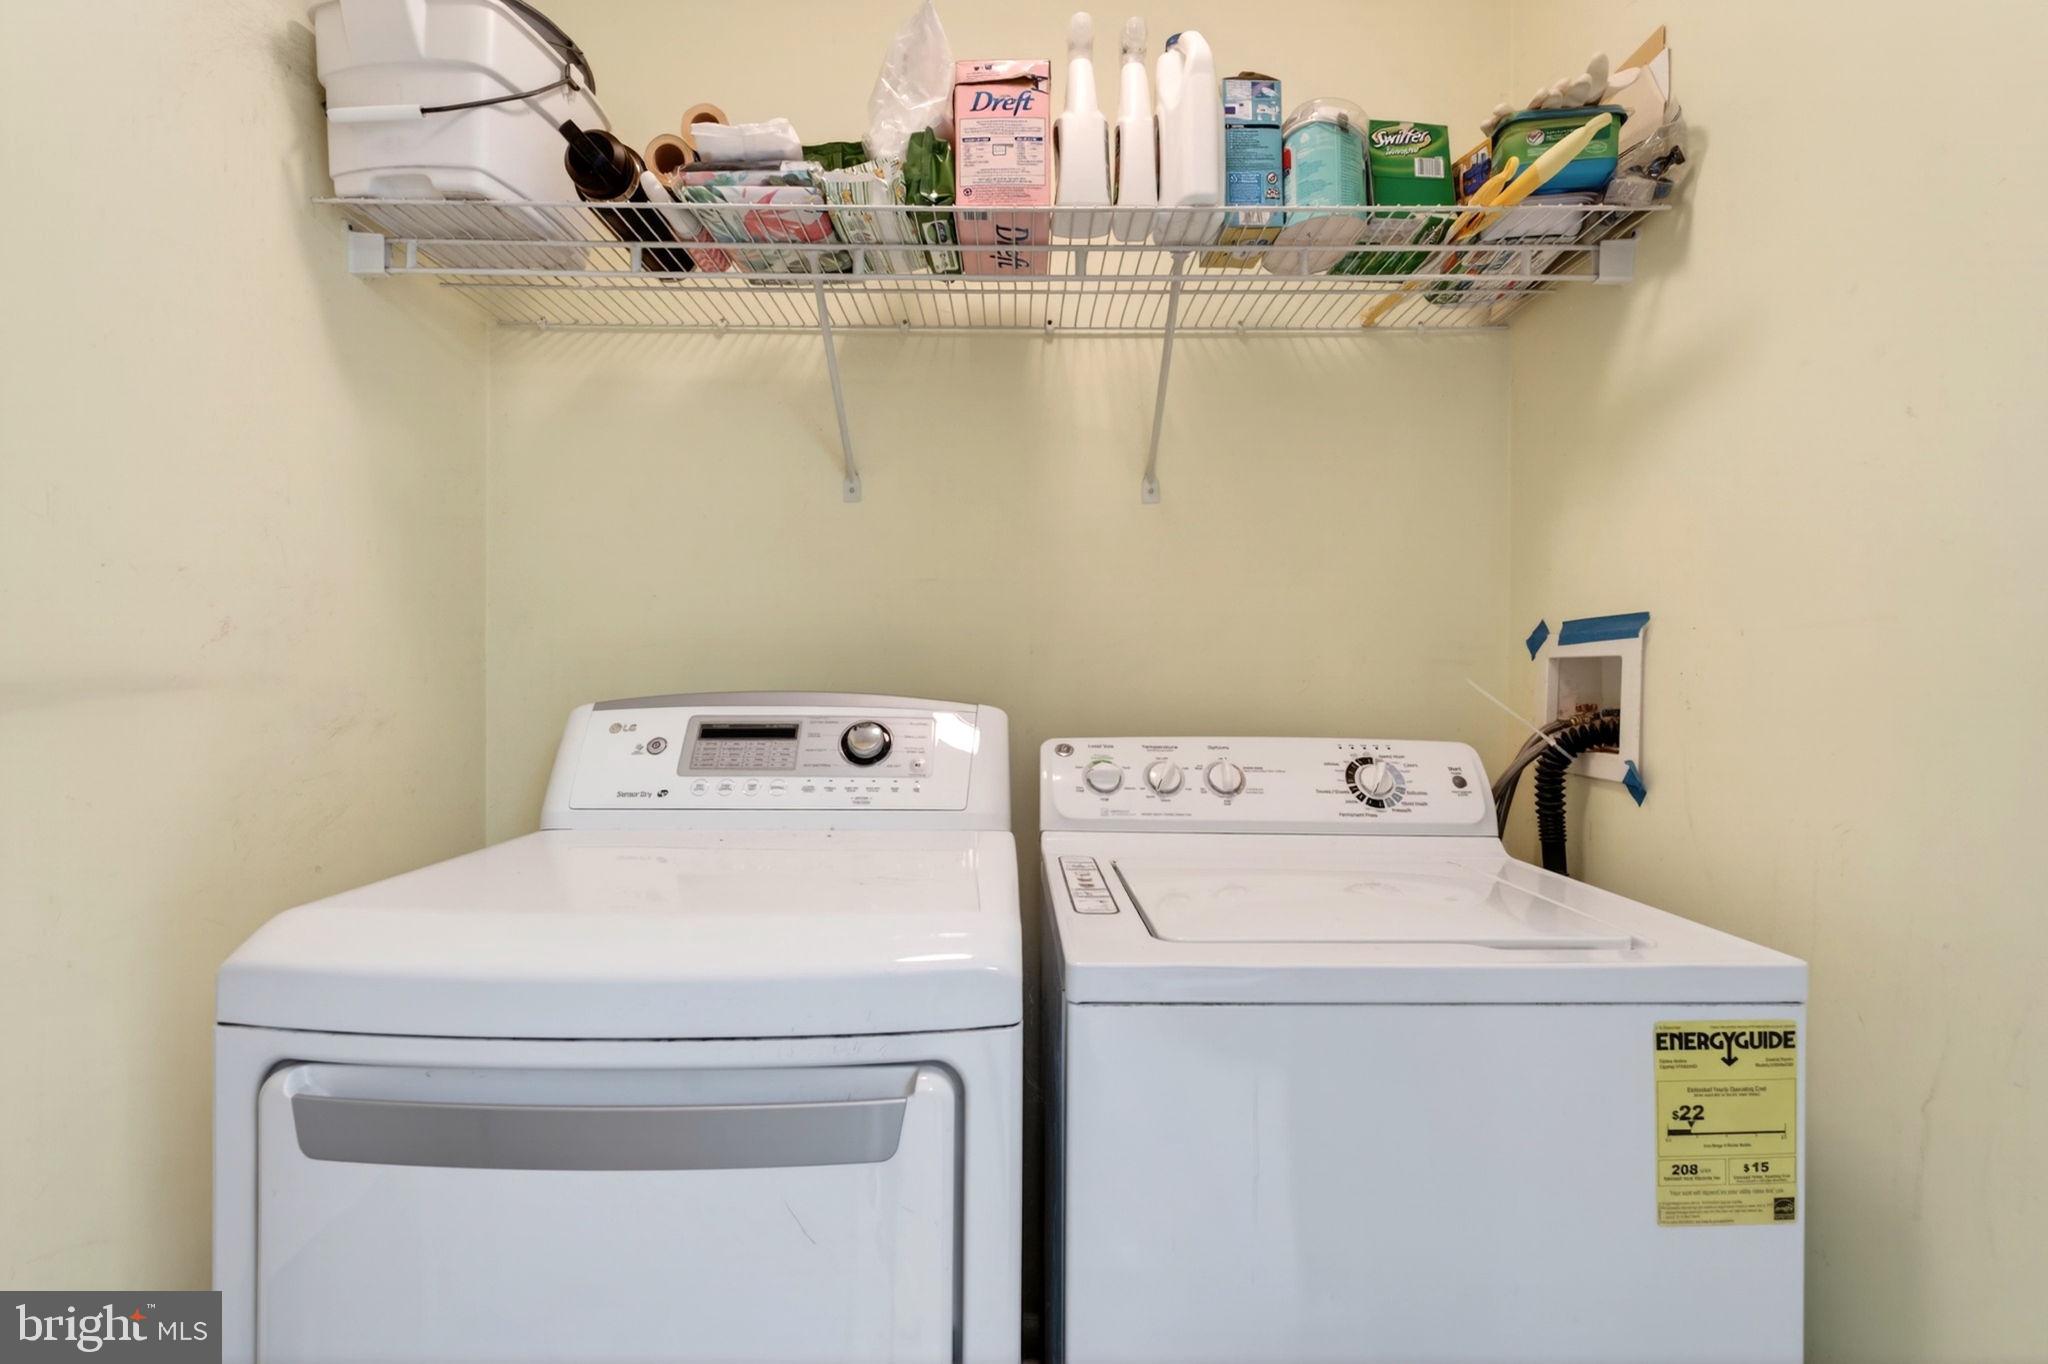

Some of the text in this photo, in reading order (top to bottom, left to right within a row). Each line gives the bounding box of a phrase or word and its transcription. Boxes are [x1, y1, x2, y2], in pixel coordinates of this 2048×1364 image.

[970, 91, 1034, 116] Dreft
[1374, 127, 1429, 148] Swiffer
[1656, 1031, 1796, 1051] ENERGYGUIDE
[1672, 1105, 1705, 1121] $22
[1672, 1164, 1698, 1175] 208
